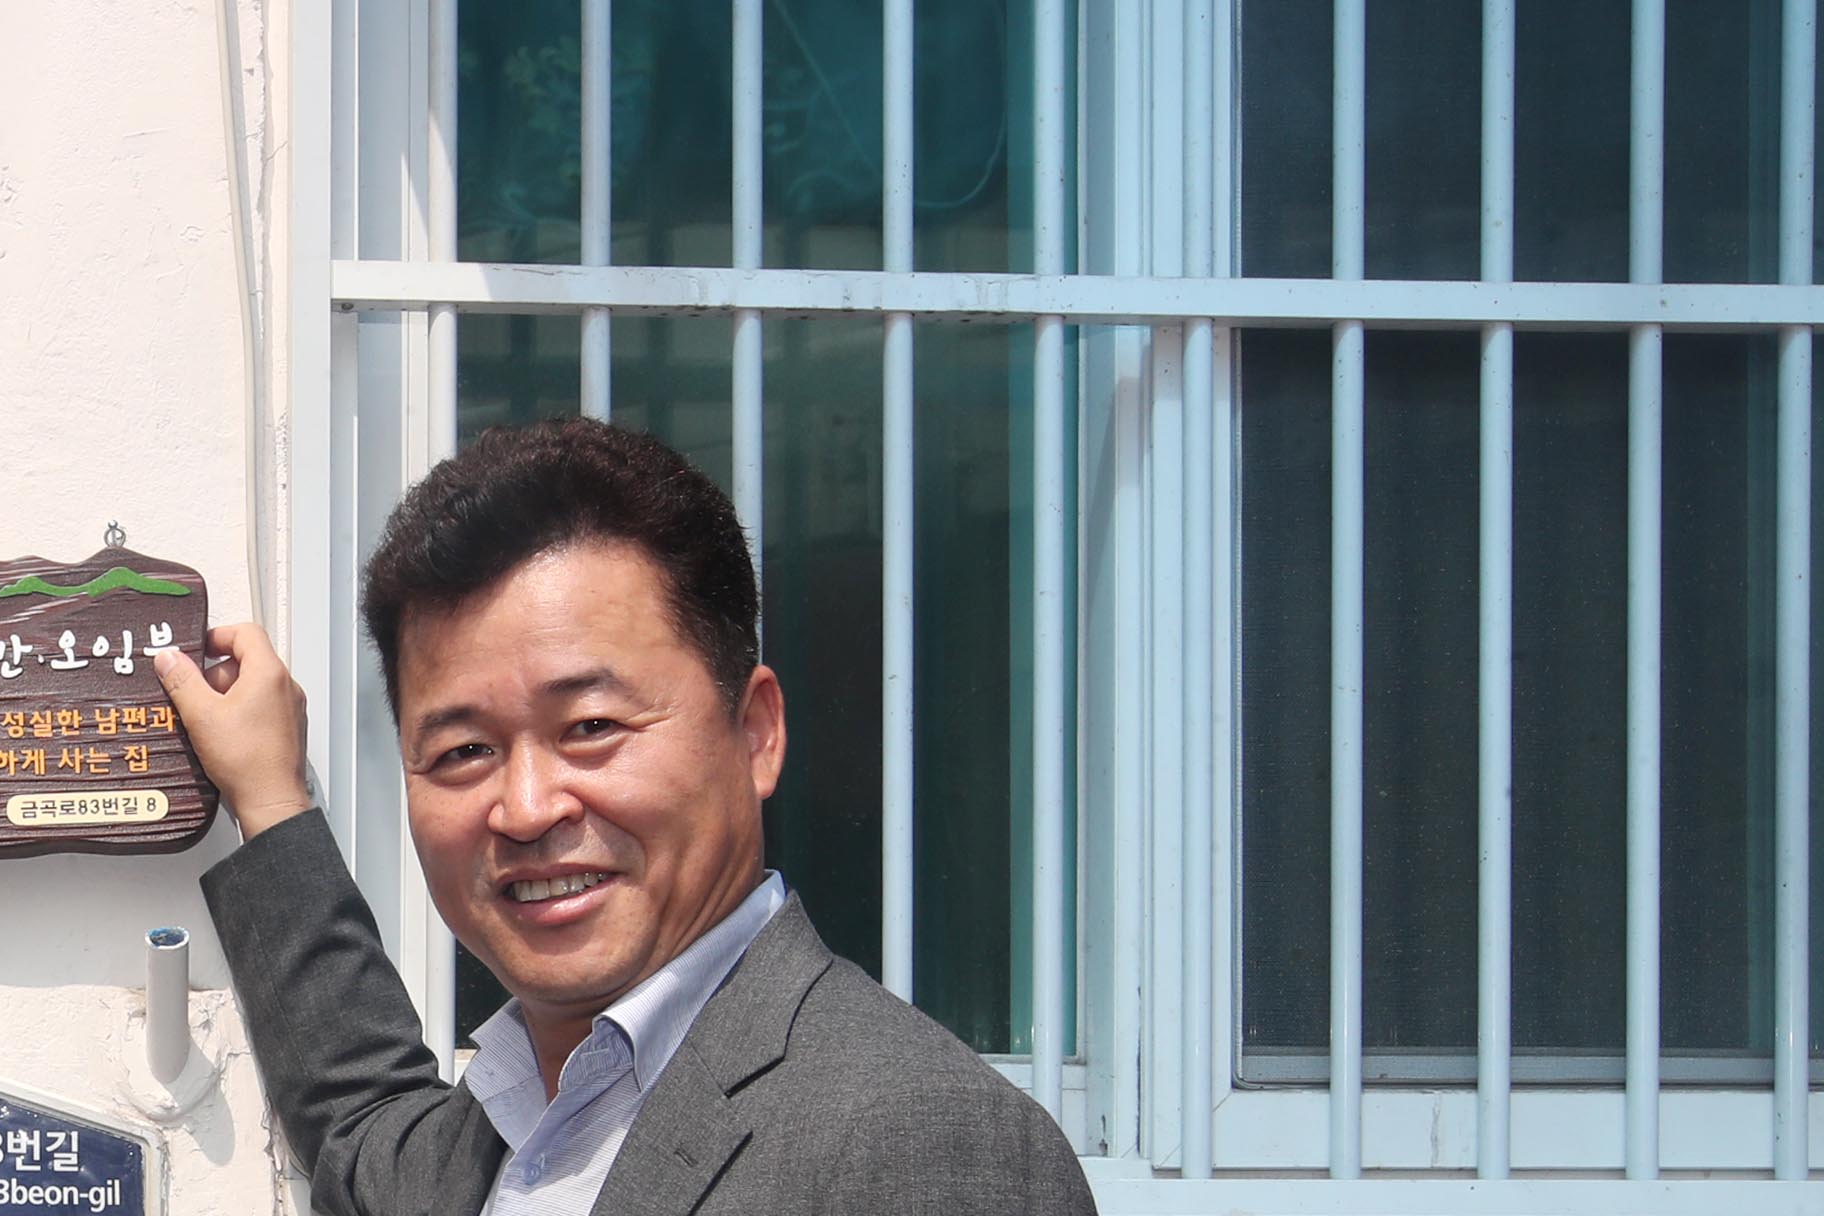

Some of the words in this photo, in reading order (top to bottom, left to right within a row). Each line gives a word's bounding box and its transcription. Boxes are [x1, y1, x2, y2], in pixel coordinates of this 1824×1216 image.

[0, 709, 83, 738] 성실한
[95, 706, 176, 735] 남편과
[57, 747, 112, 774] 사는
[124, 744, 150, 773] 집
[20, 798, 139, 819] 금곡로83번길
[146, 797, 157, 813] 8
